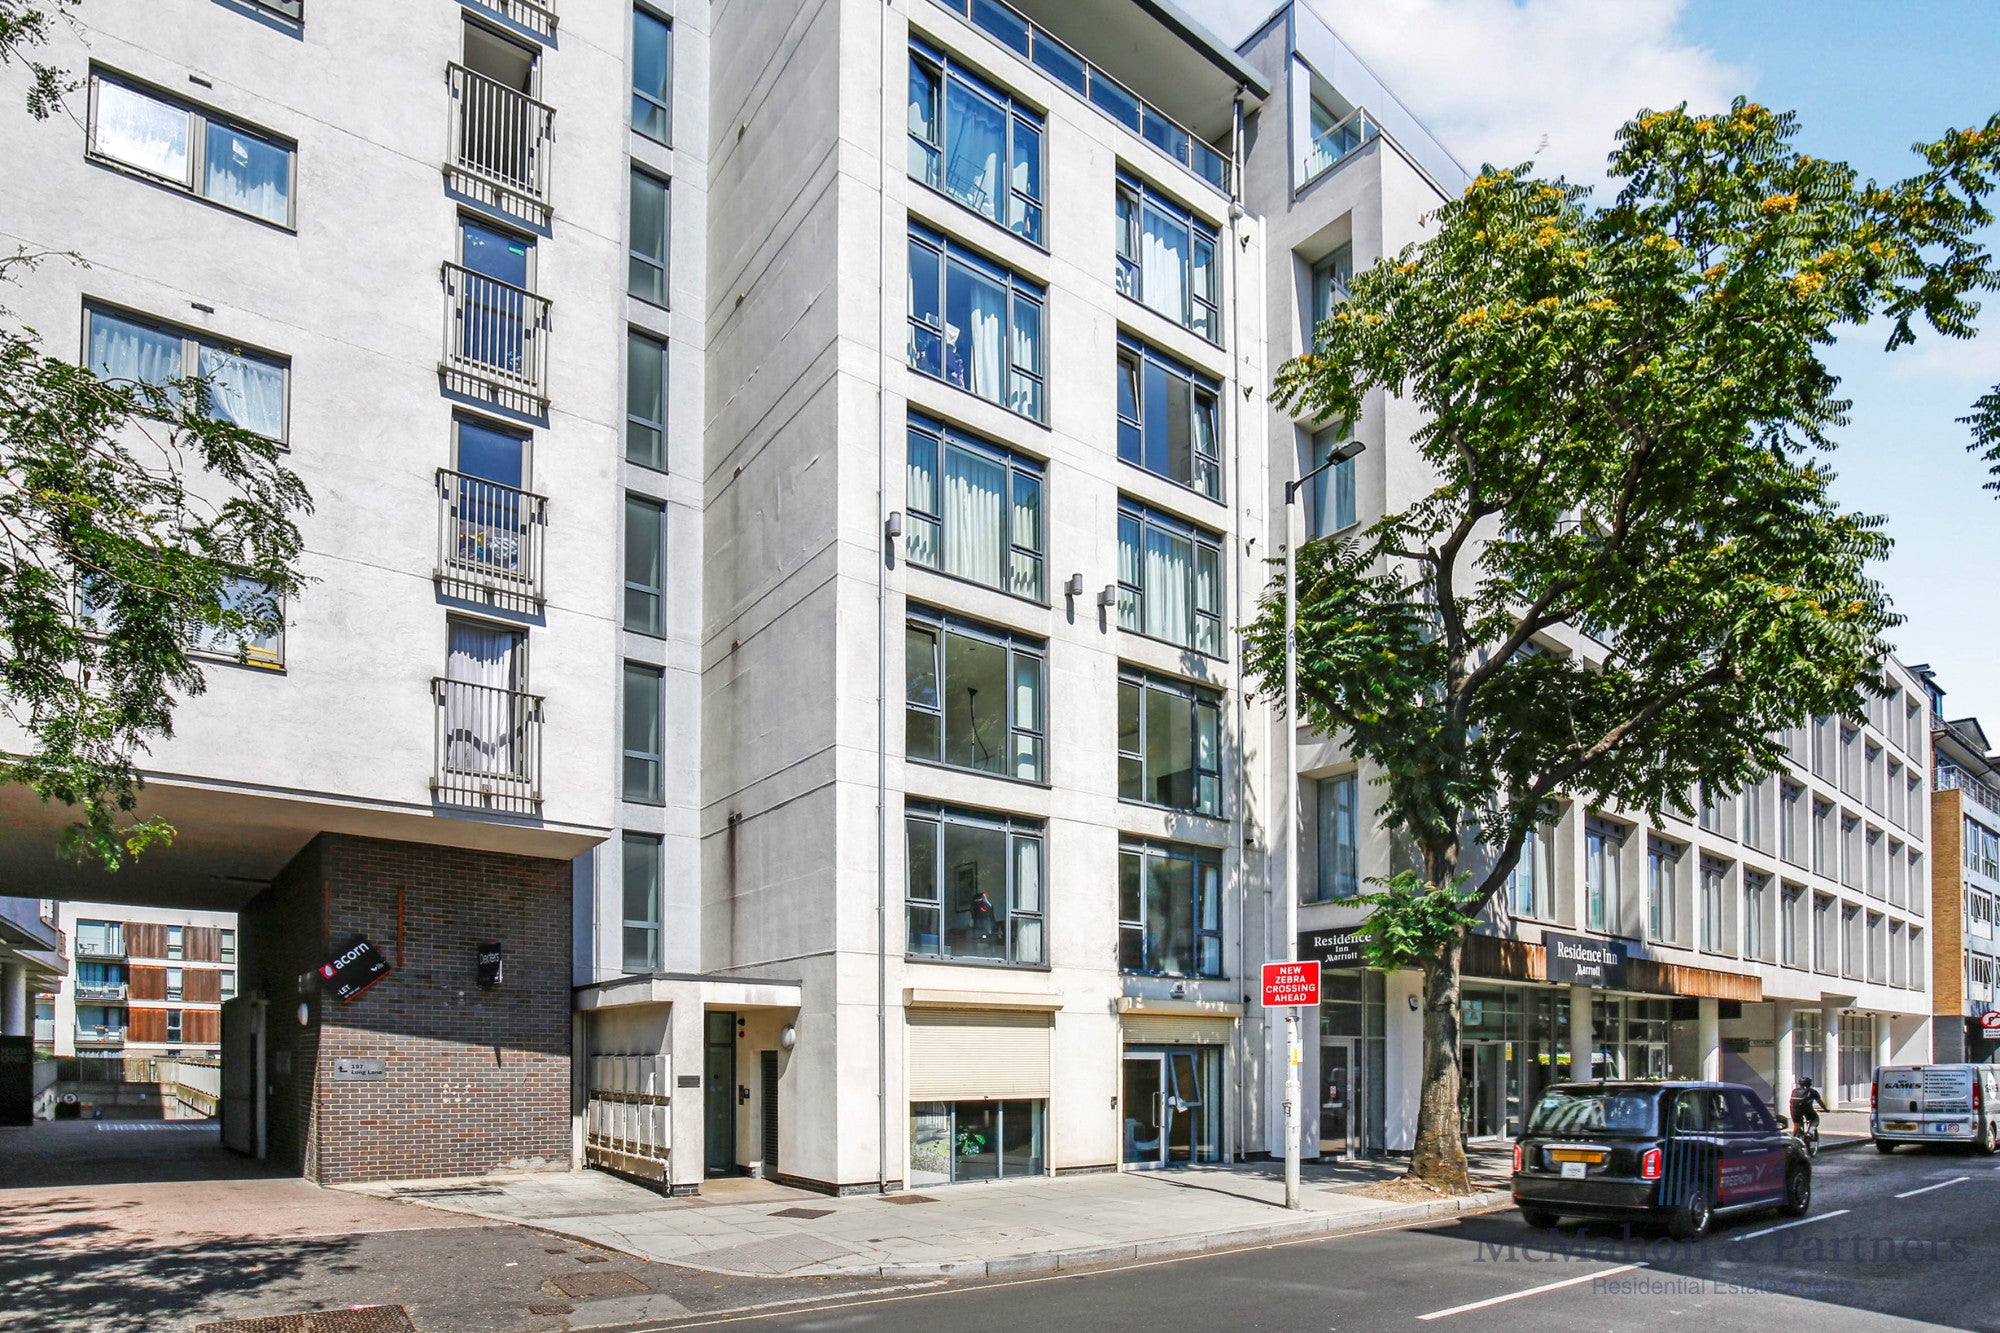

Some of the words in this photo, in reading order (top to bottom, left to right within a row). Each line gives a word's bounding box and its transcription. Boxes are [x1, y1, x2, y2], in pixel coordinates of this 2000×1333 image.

[1314, 933, 1372, 947] Residence
[333, 941, 370, 970] acorn
[1325, 952, 1358, 963] Marriott
[1557, 941, 1602, 962] Residence
[1602, 948, 1618, 965] Inn
[1280, 966, 1302, 974] NEW
[1275, 975, 1306, 984] ZEBRA
[1266, 984, 1316, 993] CROSSING
[1274, 993, 1307, 1002] AHEAD
